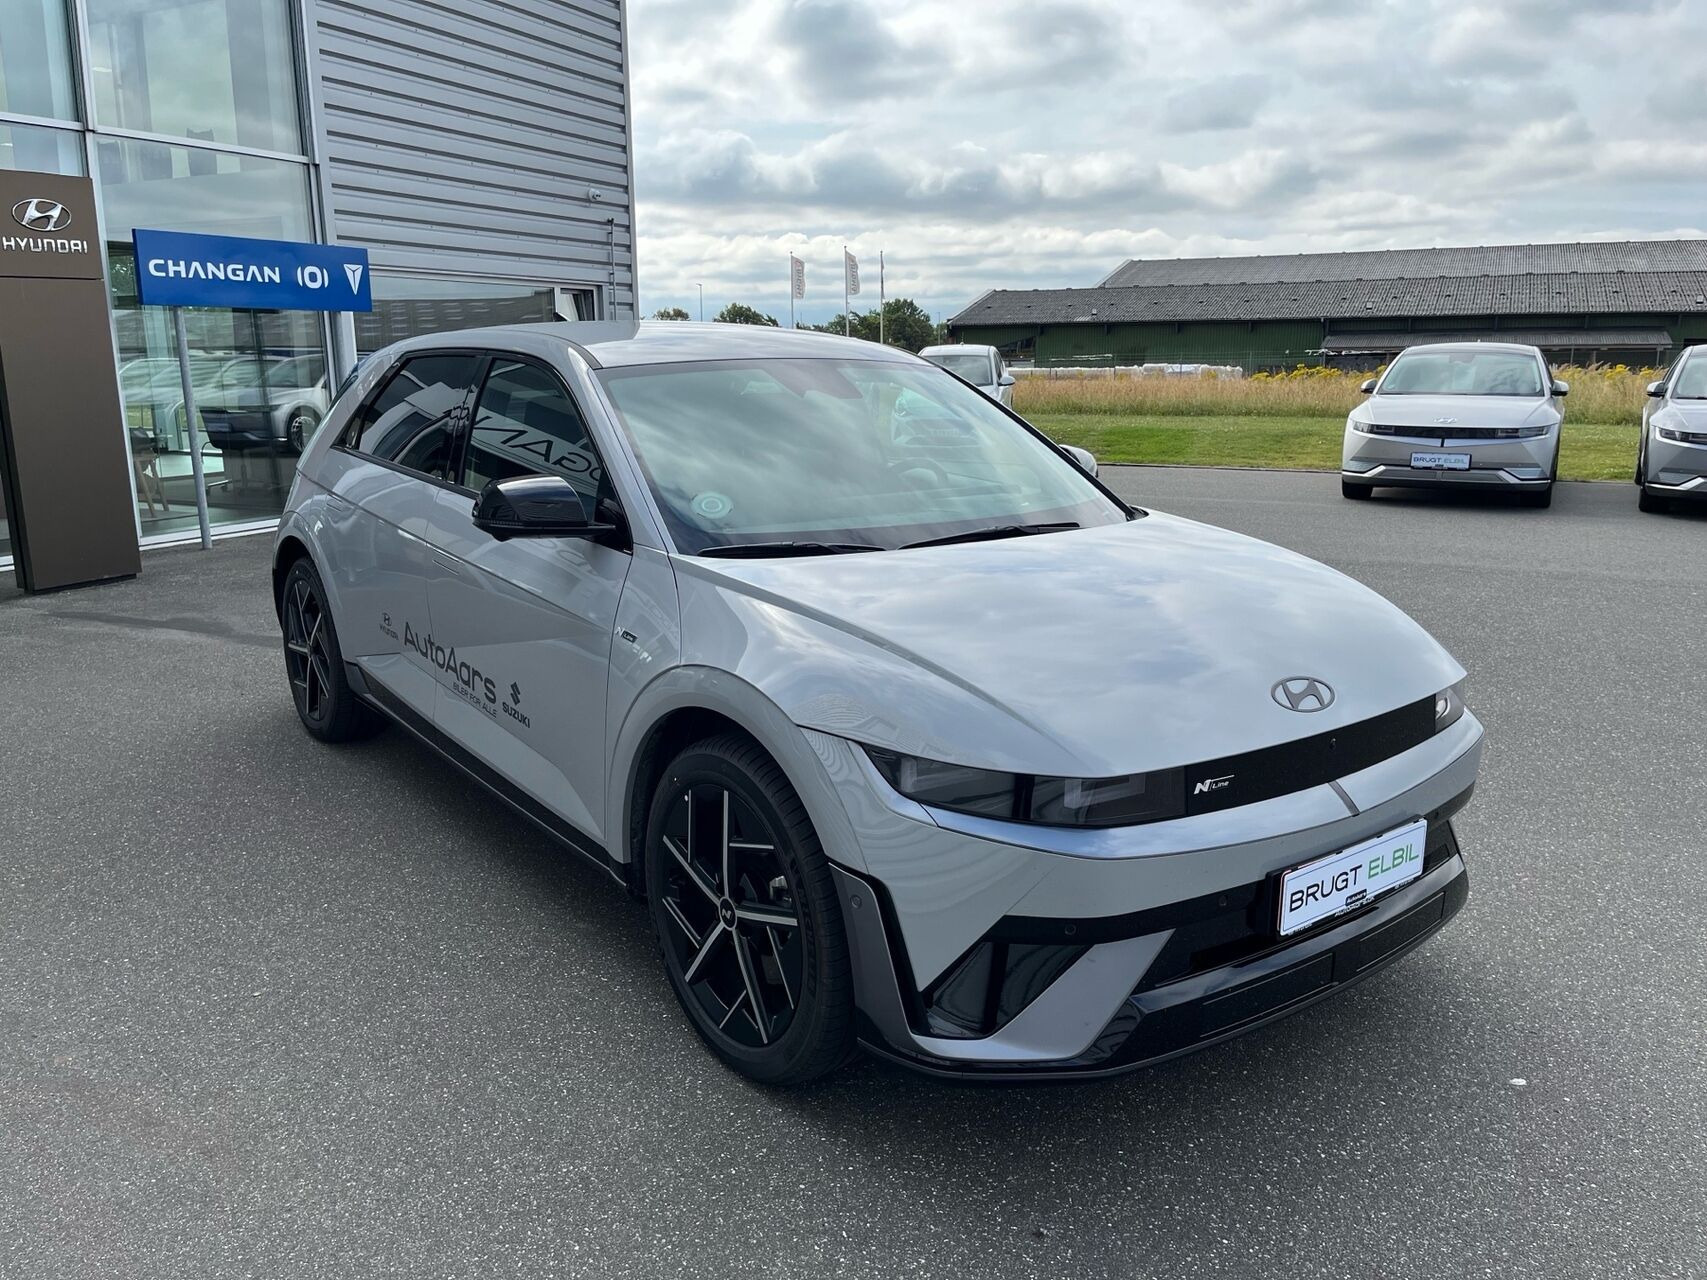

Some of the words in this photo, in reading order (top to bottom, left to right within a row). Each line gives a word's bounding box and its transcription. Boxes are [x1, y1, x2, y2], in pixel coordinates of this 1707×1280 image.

[2, 236, 88, 254] HYUNDAI
[148, 258, 281, 284] CHANGAN
[403, 621, 497, 705] AutoAars
[469, 693, 481, 707] FOR
[502, 701, 530, 729] SUZUKI
[1289, 864, 1363, 912] BRUGT
[1367, 843, 1420, 880] ELBIL
